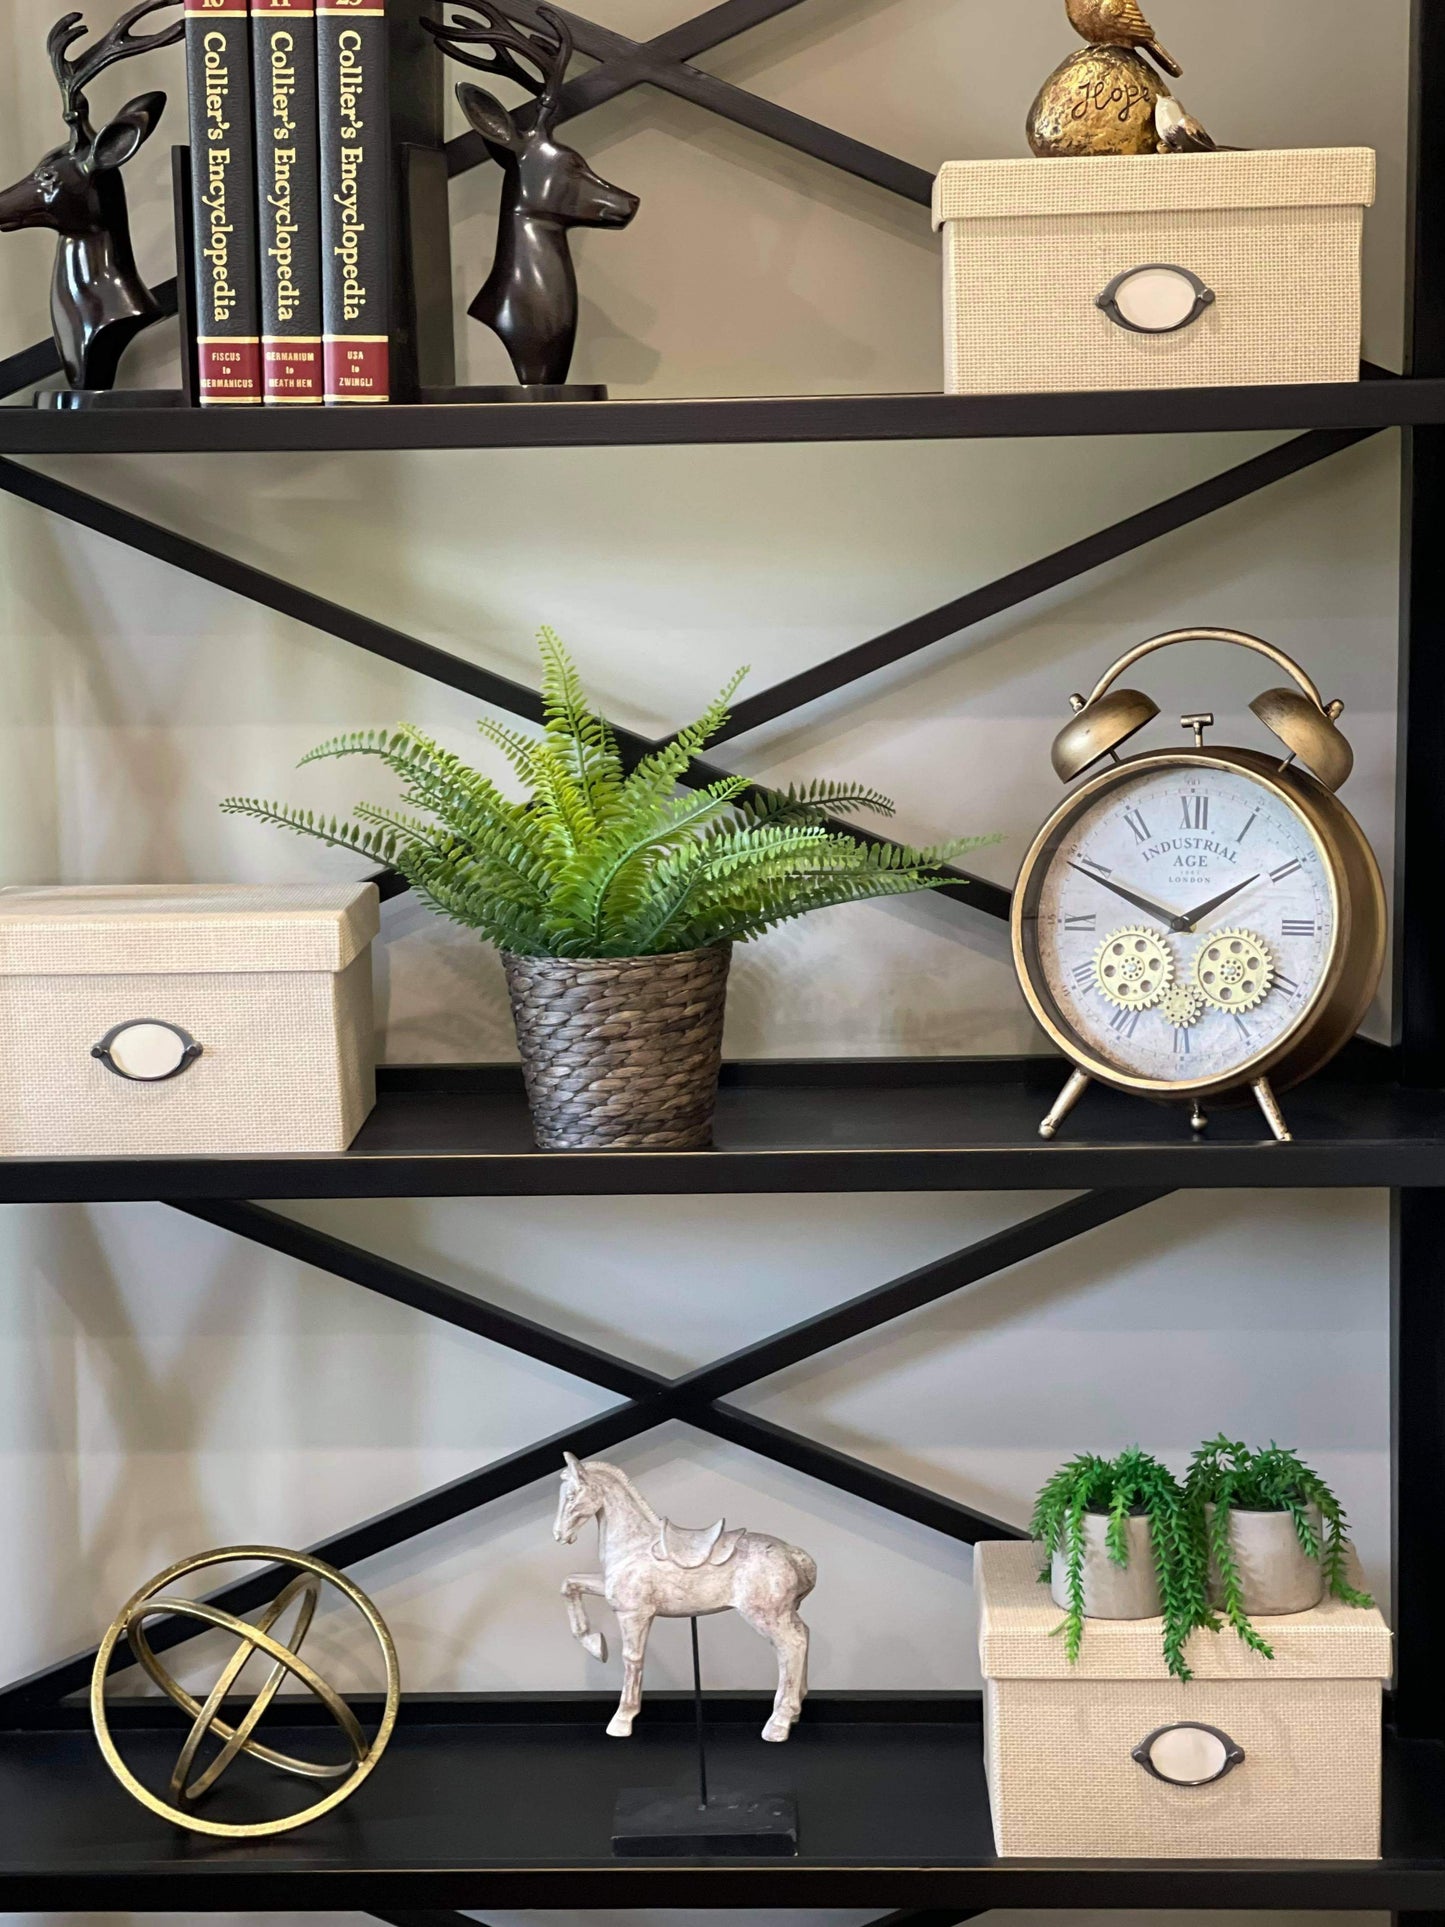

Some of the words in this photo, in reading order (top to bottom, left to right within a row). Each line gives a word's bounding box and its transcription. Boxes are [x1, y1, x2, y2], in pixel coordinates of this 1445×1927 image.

[203, 31, 231, 140] Collier's
[270, 30, 297, 140] Collier's
[338, 29, 364, 139] Collier's
[1071, 81, 1150, 122] Hope
[201, 147, 236, 322] Encyclopedia
[267, 147, 300, 322] Encyclopedia
[333, 146, 366, 321] Encyclopedia
[212, 352, 241, 361] FISCUS
[222, 366, 231, 374] to
[285, 366, 295, 374] to
[347, 351, 364, 360] USA
[351, 365, 360, 373] to
[1179, 795, 1209, 830] XII
[1141, 837, 1238, 864] INDUSTRIAL
[1172, 855, 1208, 868] AGE
[1168, 876, 1212, 884] LONDON
